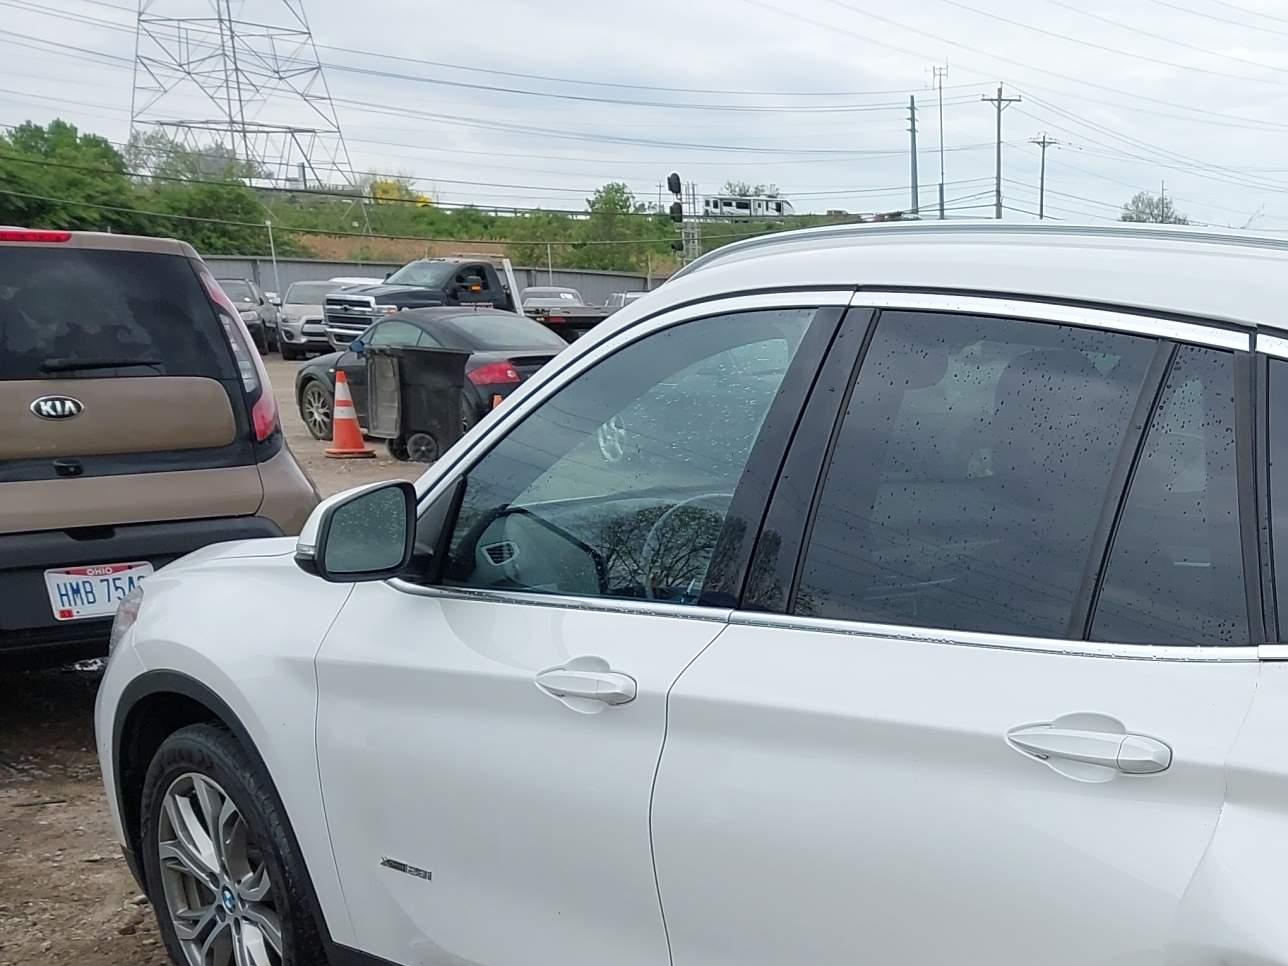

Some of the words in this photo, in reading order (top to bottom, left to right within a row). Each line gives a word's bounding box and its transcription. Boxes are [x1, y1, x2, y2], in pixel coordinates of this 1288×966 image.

[39, 400, 78, 416] KIA
[86, 566, 113, 576] OHIO
[56, 580, 97, 607] HMB
[99, 575, 145, 603] 75A
